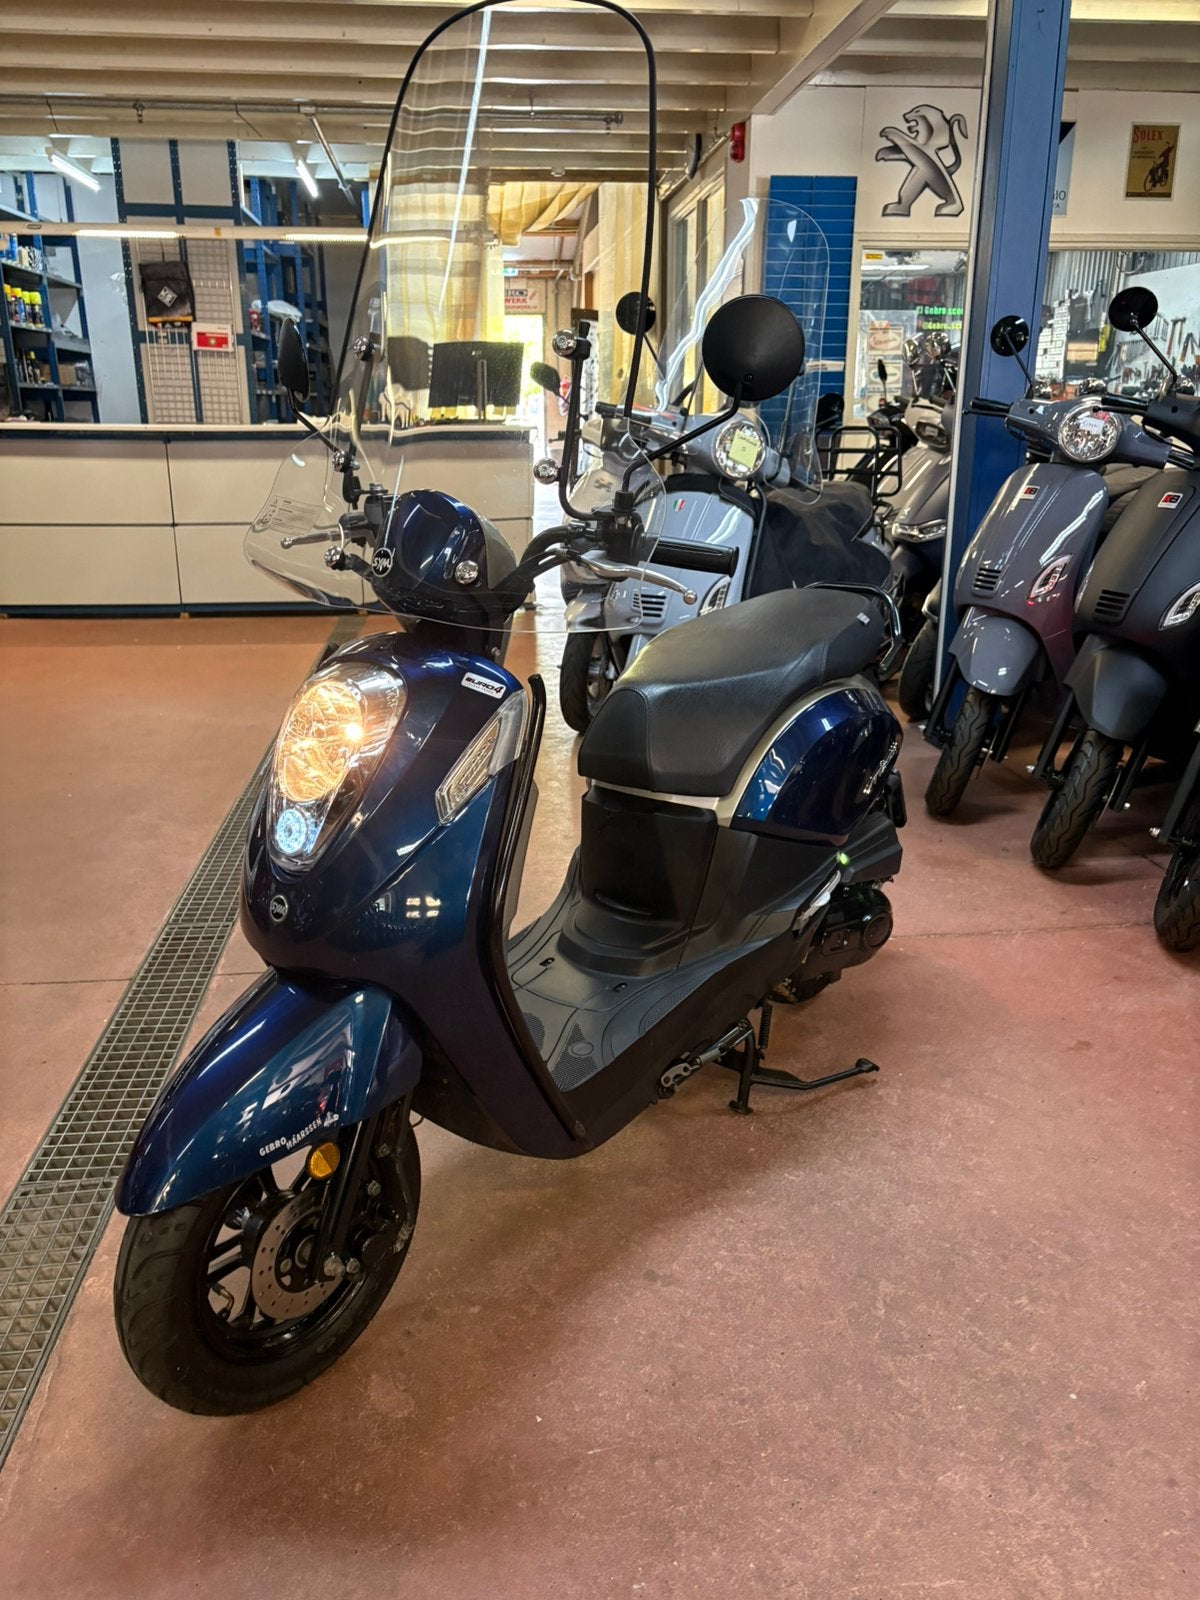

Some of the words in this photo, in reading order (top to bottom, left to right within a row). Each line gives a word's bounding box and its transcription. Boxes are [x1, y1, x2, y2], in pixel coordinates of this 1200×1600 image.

[1132, 127, 1164, 143] SOLEX
[372, 557, 392, 571] SYM
[464, 676, 504, 693] EURO4
[259, 1136, 287, 1157] GEBRO
